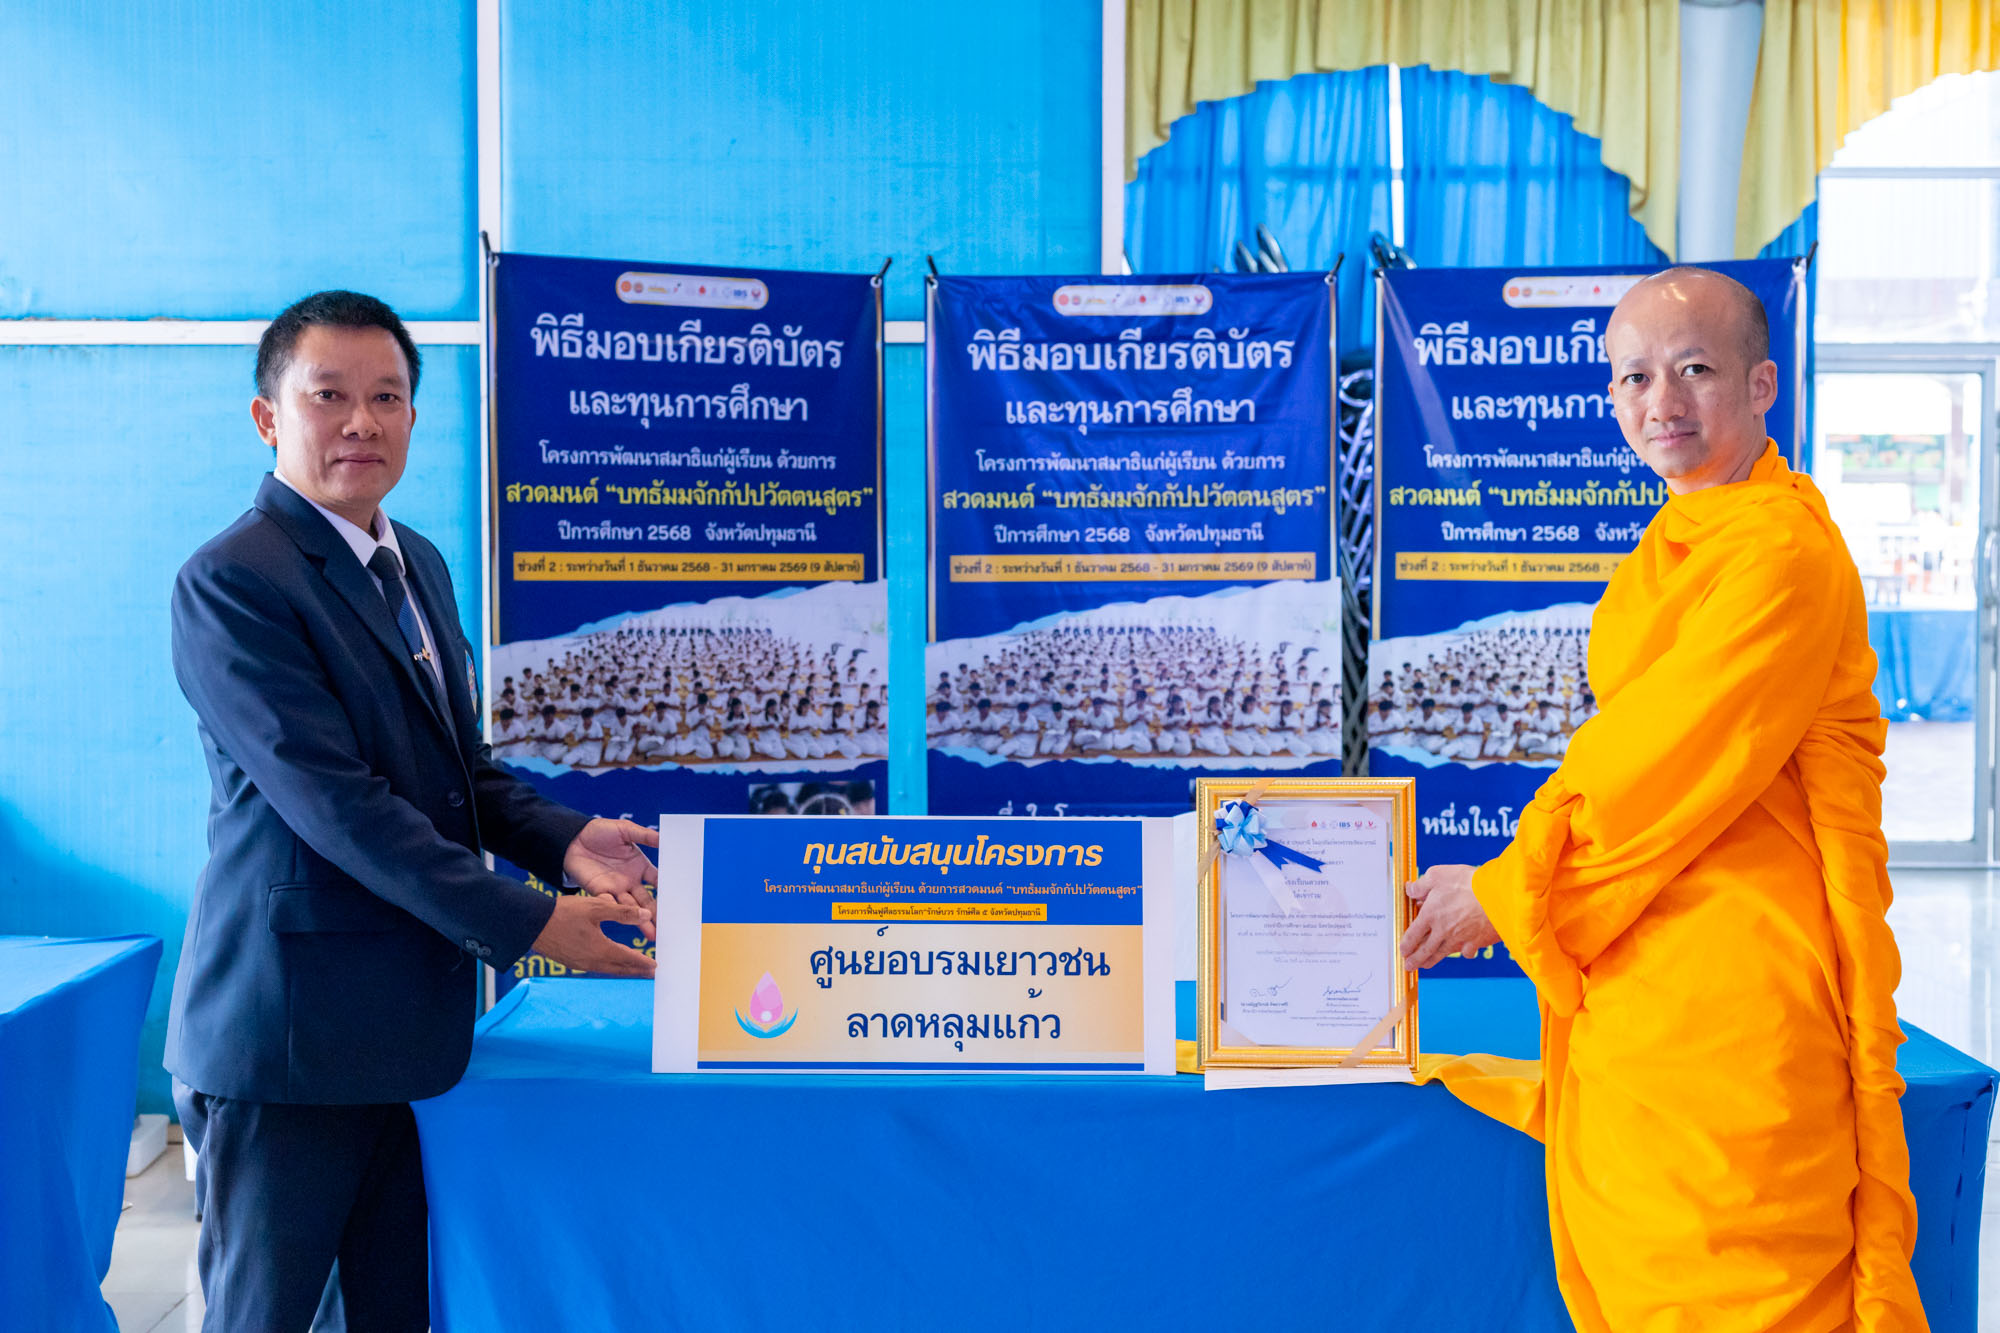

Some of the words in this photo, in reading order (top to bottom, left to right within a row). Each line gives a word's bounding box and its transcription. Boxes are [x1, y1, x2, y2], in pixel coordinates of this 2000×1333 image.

[530, 312, 844, 369] พิธีมอบเกียรติบัตร
[967, 327, 1295, 371] พิธีมอบเกียรติบัตร
[570, 383, 807, 429] และทุนการศึกษา
[1005, 386, 1255, 435] และทุนการศึกษา
[539, 439, 772, 474] โครงการพัฒนาสมาธิแก่ผู้เรียน
[777, 449, 836, 469] ด้วยการ
[975, 449, 1217, 477] โครงการพัฒนาสมาธิแก่ผู้เรียน
[1221, 450, 1285, 470] ด้วยการ
[506, 477, 599, 504] สวดมนต์
[943, 483, 1035, 509] สวดมนต์
[1390, 479, 1481, 506] สวดมนต์
[1488, 479, 1668, 507] “บทธัมมจักกัปป
[558, 520, 643, 541] ปีการศึกษา
[647, 525, 691, 541] 2568
[705, 522, 817, 547] จังหวัดปทุมธานี
[994, 522, 1080, 543] ปีการศึกษา
[1085, 527, 1130, 543] 2568
[1145, 522, 1264, 547] จังหวัดปทุมธานี
[1441, 521, 1527, 541] ปีการศึกษา
[1532, 525, 1580, 541] 2568
[517, 557, 545, 573] ช่วงที่
[549, 562, 557, 572] 2
[566, 557, 626, 573] ระหว่างวันที่
[637, 561, 679, 573] ธันวาคม
[682, 562, 710, 573] 2568
[722, 562, 733, 573] 31
[737, 563, 777, 573] มกราคม
[780, 562, 807, 573] 2569
[810, 561, 820, 574] (9
[954, 559, 983, 574] ช่วงที่
[985, 564, 993, 574] 2
[1002, 560, 1062, 574] ระหว่างวันที่
[1074, 562, 1117, 573] ธันวาคม
[1120, 563, 1150, 573] 2568
[1162, 563, 1175, 573] 31
[1178, 563, 1220, 573] มกราคม
[1223, 562, 1254, 572] 2569
[1256, 561, 1268, 574] (9
[1399, 556, 1428, 572] ช่วงที่
[1431, 562, 1439, 572] 2
[1449, 558, 1508, 573] ระหว่างวันที่
[1520, 561, 1565, 573] ธันวาคม
[1568, 562, 1601, 573] 2568
[802, 834, 1104, 875] ทุนสนับสนุนโครงการ
[763, 879, 915, 898] โครงการพัฒนาสมาธิแก่ผู้เรียน
[918, 881, 1003, 896] ด้วยการสวดมนต์
[809, 925, 1111, 989] ศูนย์อบรมเยาวชน
[846, 987, 1062, 1053] ลาดหลุมแก้ว
